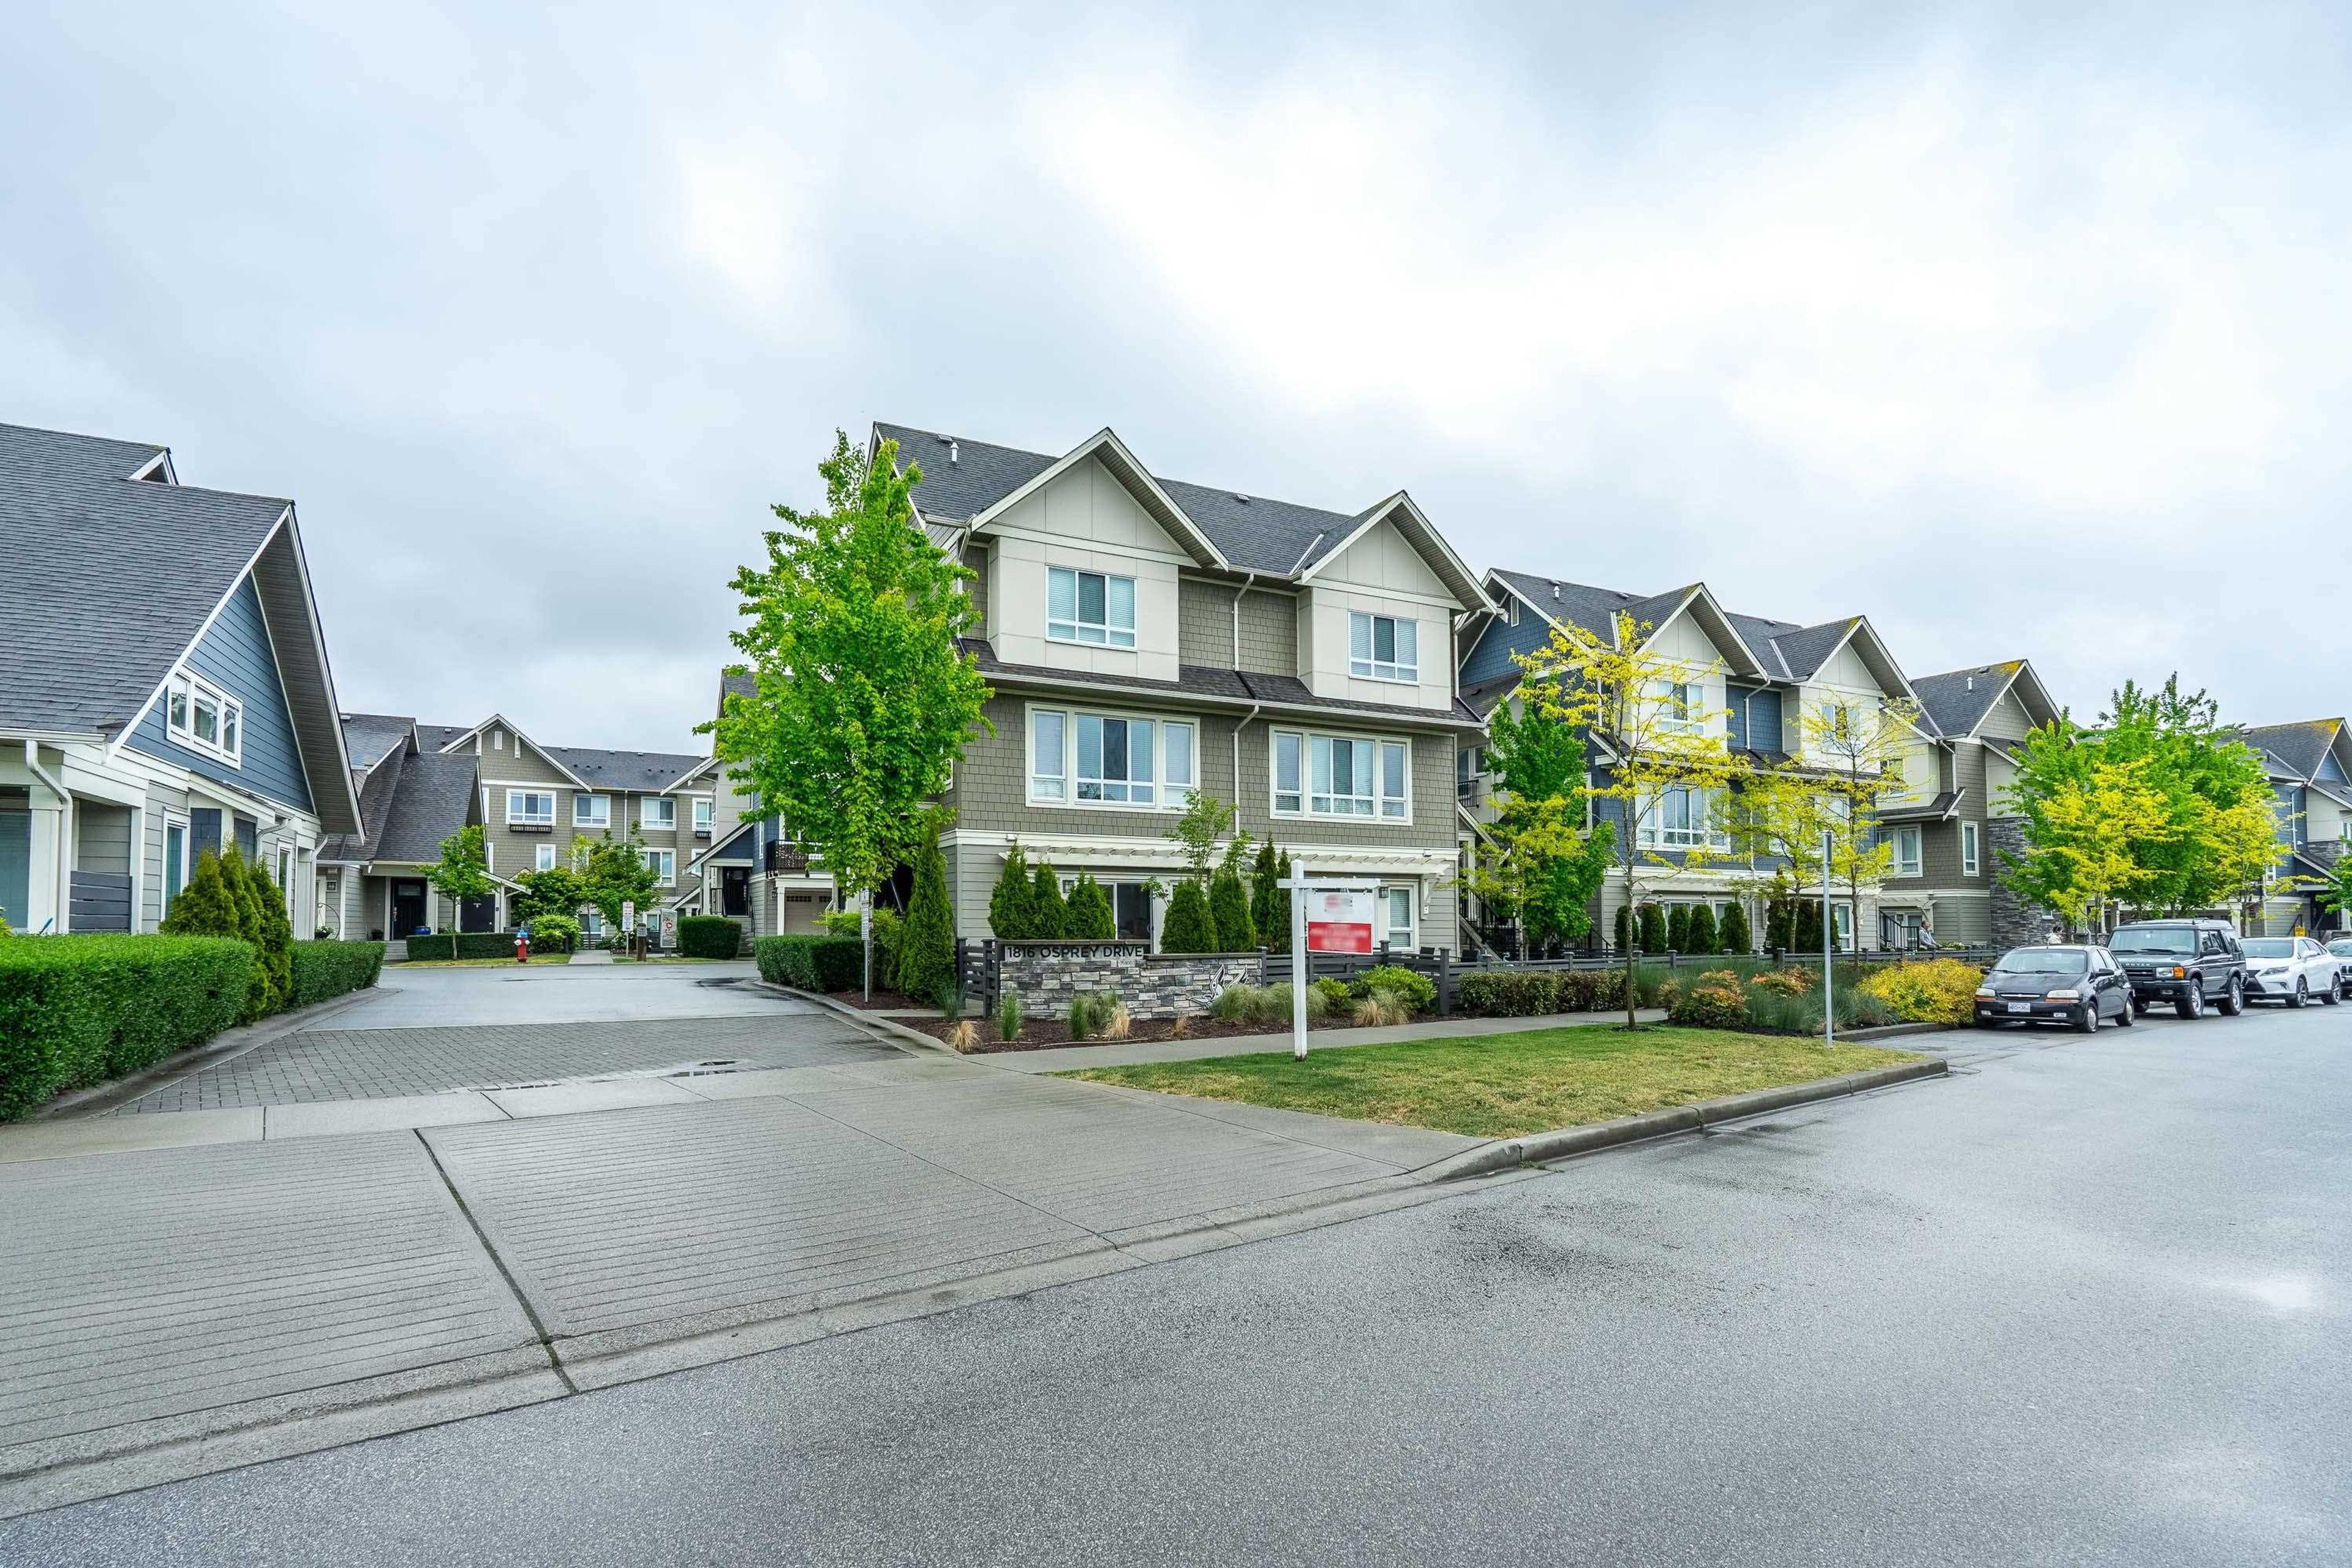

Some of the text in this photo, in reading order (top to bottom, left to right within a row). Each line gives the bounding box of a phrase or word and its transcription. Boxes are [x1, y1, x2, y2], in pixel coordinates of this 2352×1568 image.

[1008, 946, 1142, 957] 1816 OSPREY DRIVE
